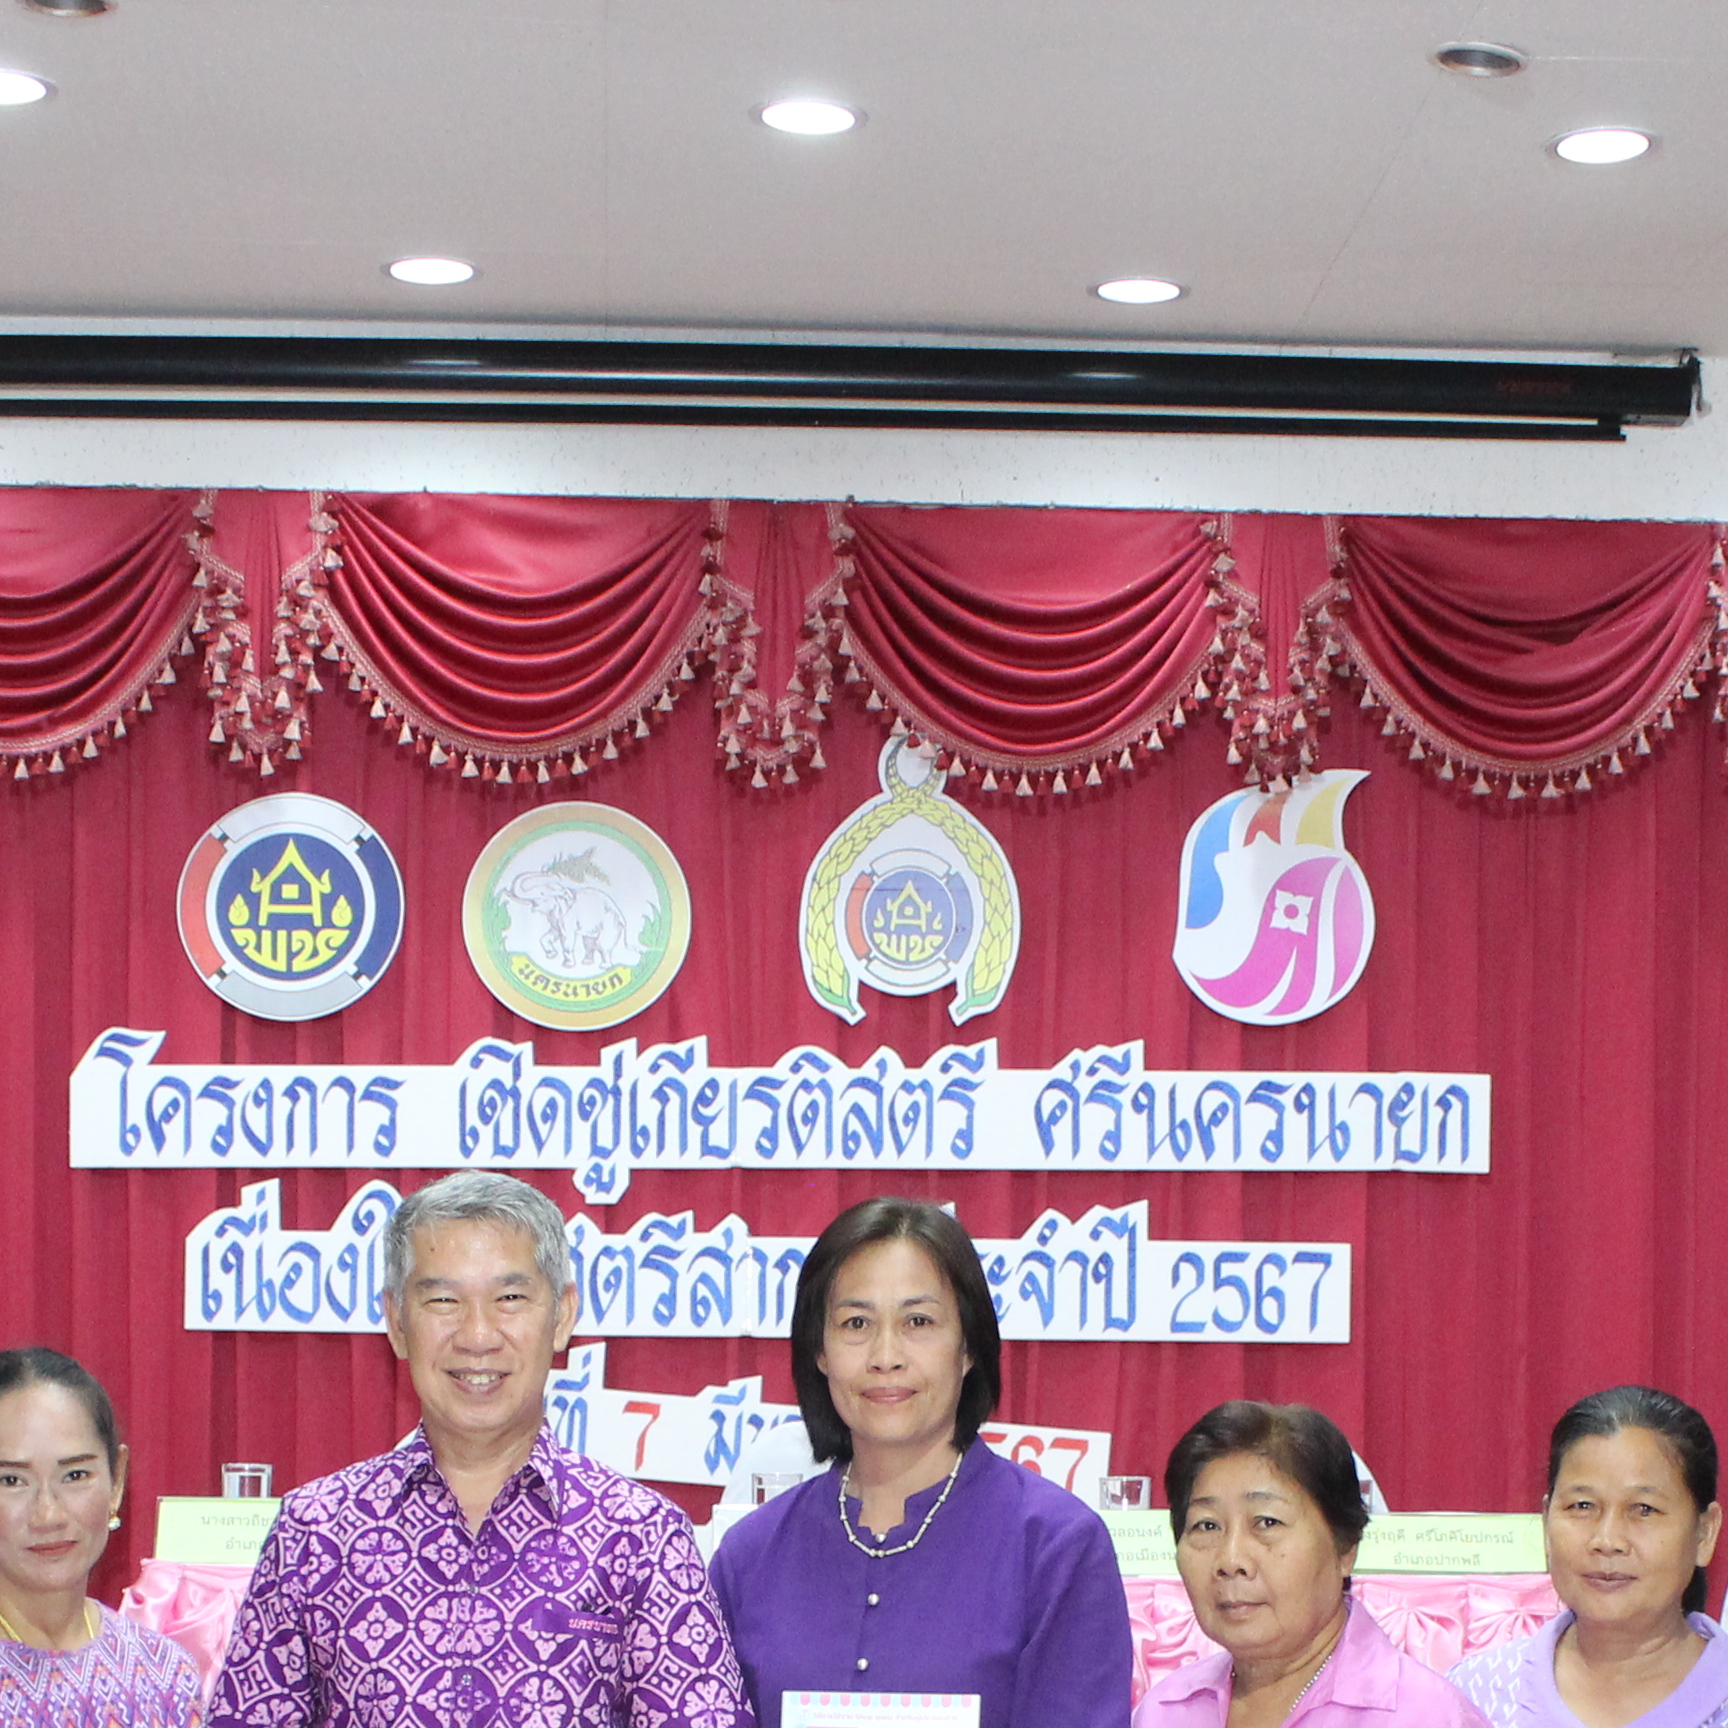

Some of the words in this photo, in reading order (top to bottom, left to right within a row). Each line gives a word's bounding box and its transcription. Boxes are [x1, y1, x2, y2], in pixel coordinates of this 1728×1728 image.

[516, 963, 624, 1000] นครนายก
[94, 1032, 406, 1158] โครงการ
[458, 1043, 986, 1194] เชิดชูเกียรติสตรี
[1033, 1047, 1471, 1164] ศรีนครนายก
[1169, 1250, 1334, 1334] 2567
[622, 1400, 662, 1472] 7
